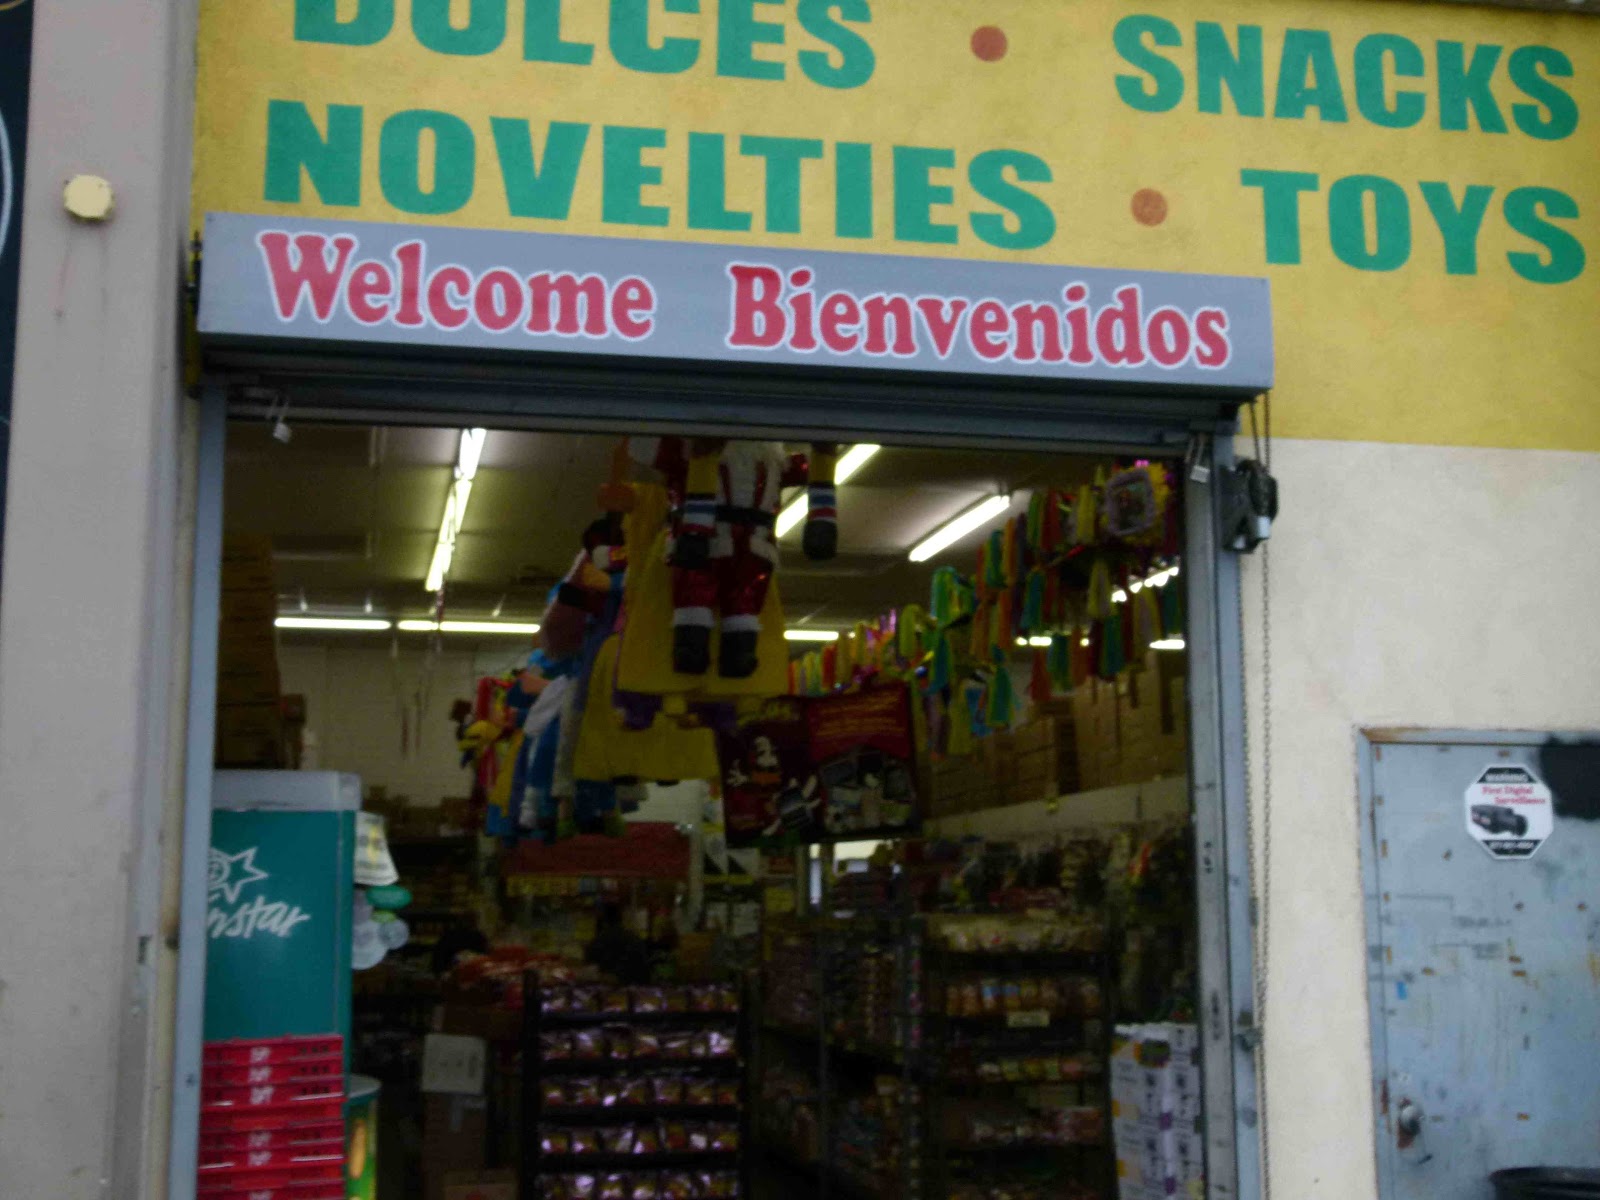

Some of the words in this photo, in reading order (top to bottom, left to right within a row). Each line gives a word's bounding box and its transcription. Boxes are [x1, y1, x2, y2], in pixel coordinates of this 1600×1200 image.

[1112, 14, 1580, 140] SNACKS
[263, 99, 1057, 250] NOVELTIES
[1240, 168, 1586, 284] TOYS
[259, 231, 655, 340] Welcome
[728, 263, 1230, 369] Bienvenidos
